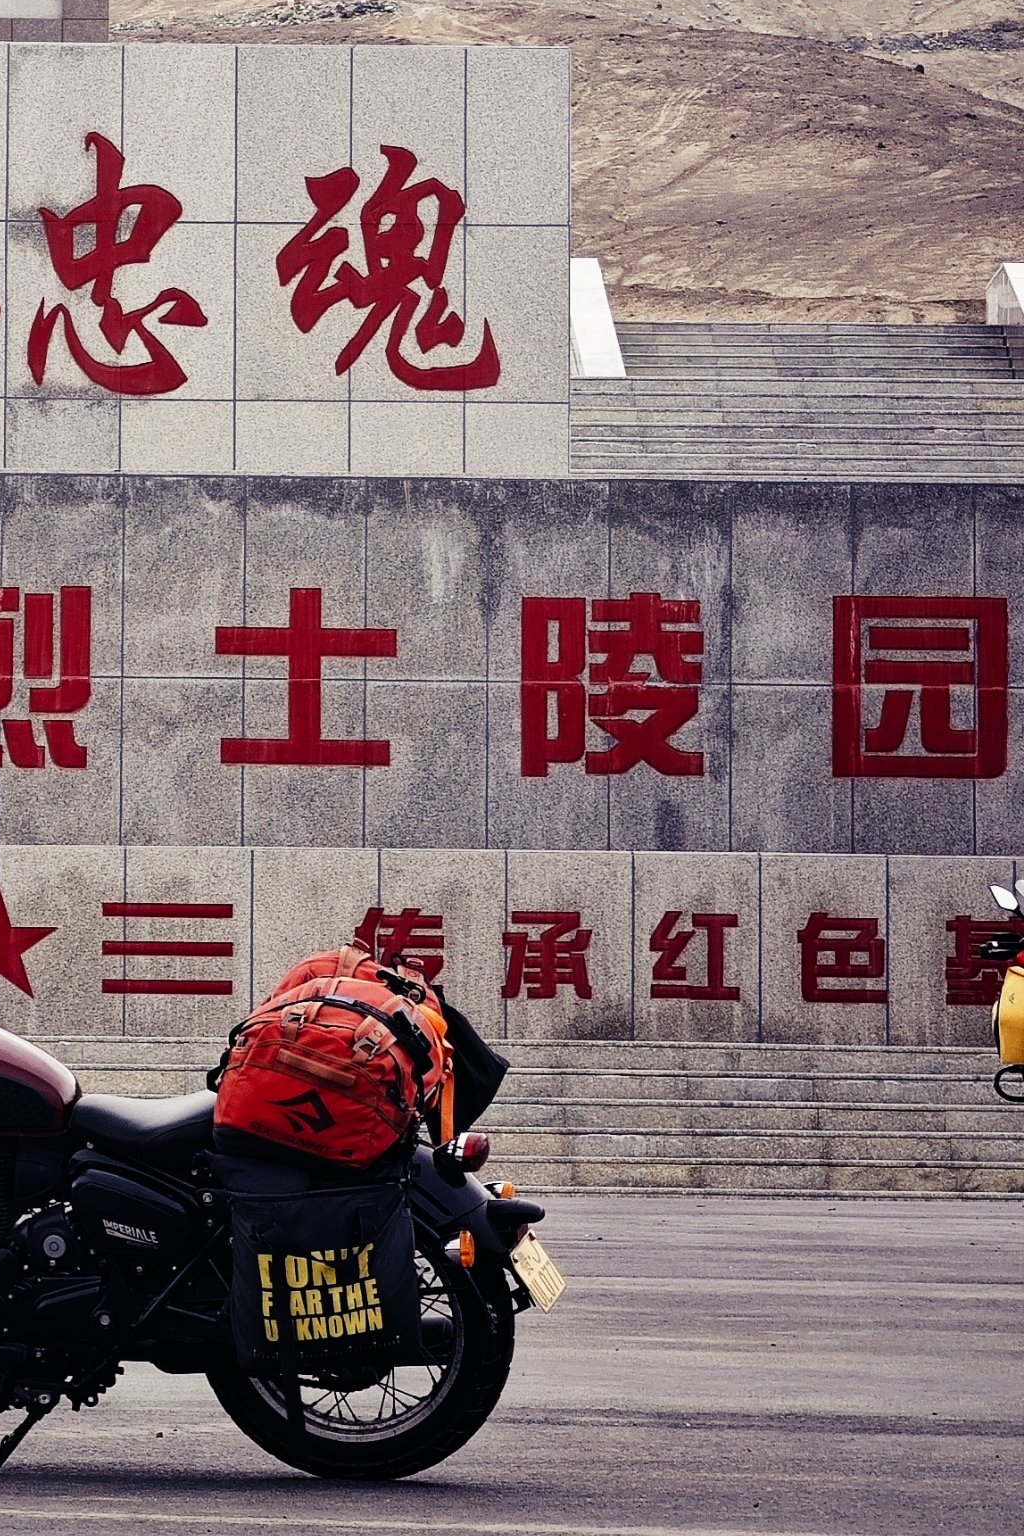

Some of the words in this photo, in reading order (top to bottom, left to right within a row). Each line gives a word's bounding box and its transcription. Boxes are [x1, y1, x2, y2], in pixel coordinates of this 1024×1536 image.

[102, 1218, 159, 1244] IMPERIALE
[262, 1289, 323, 1317] FAR
[328, 1278, 381, 1313] THE
[264, 1306, 383, 1342] UKNOWN
